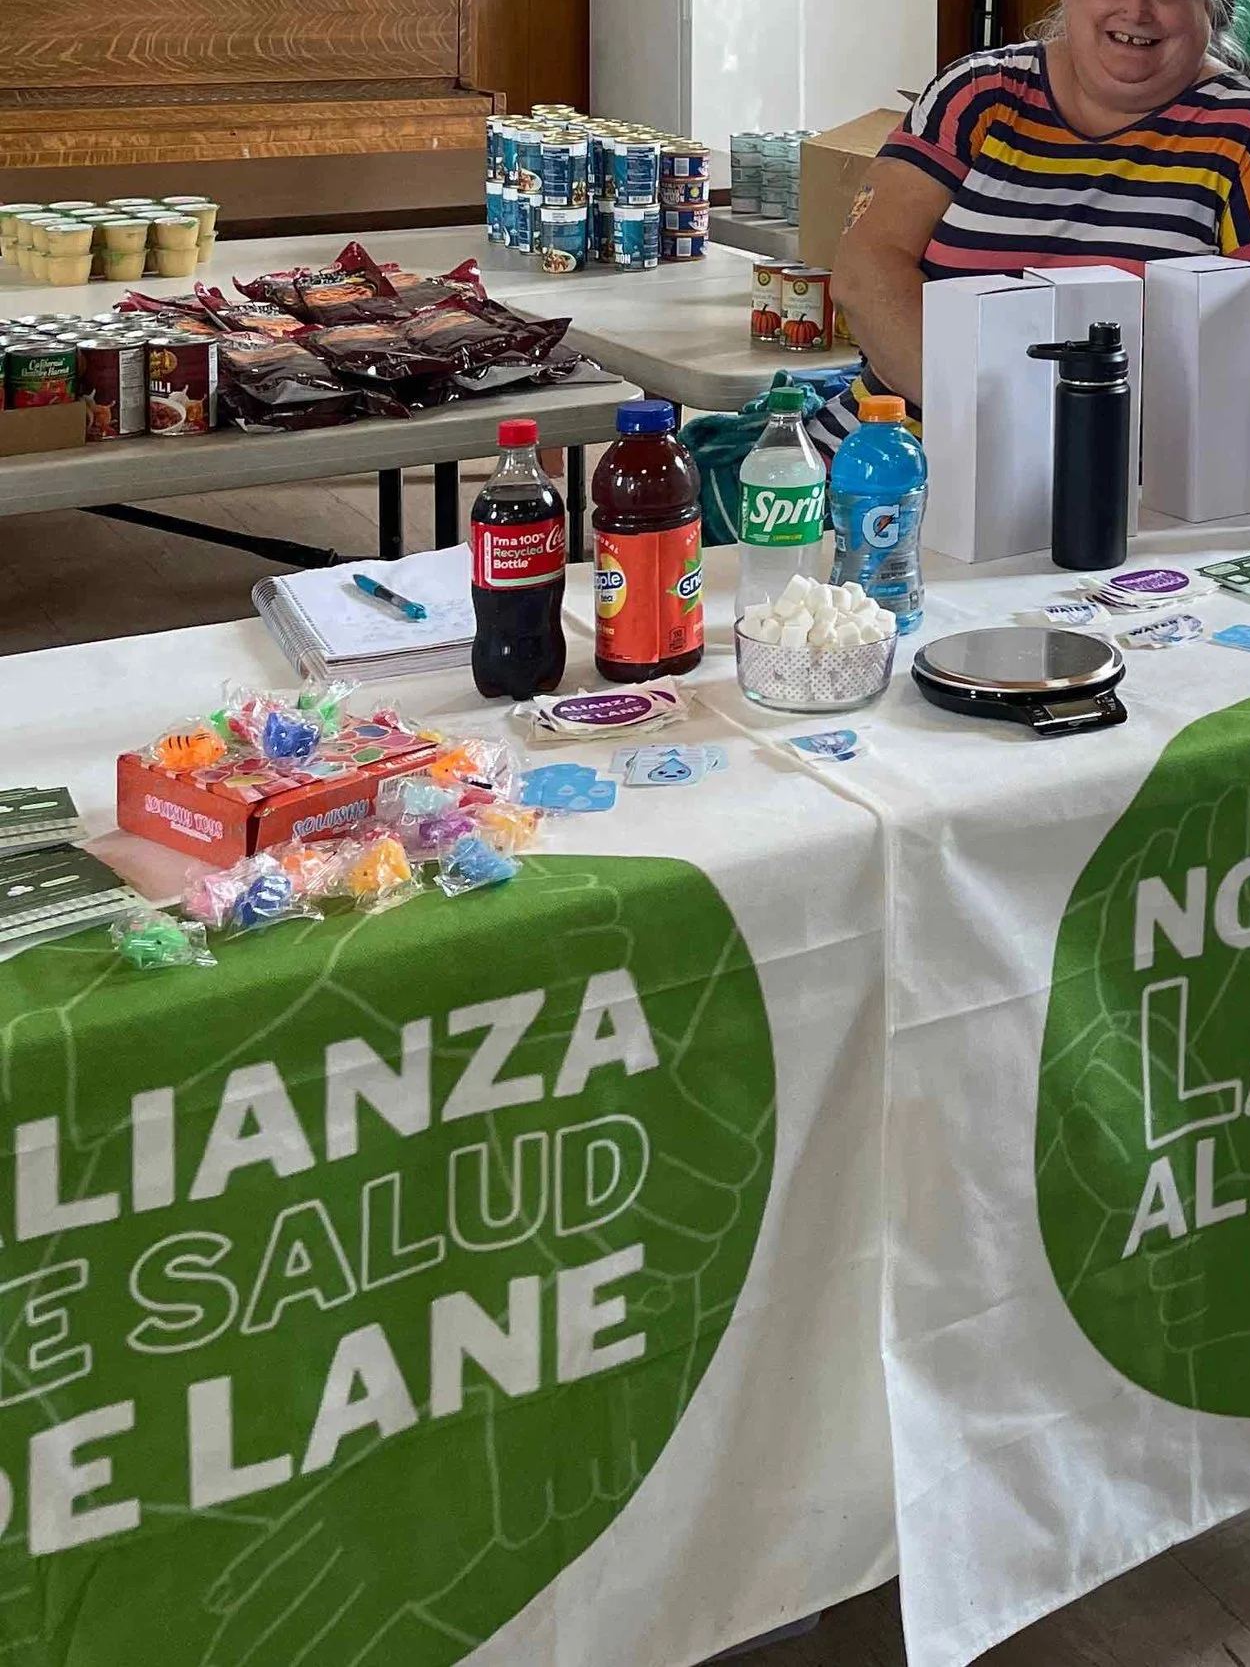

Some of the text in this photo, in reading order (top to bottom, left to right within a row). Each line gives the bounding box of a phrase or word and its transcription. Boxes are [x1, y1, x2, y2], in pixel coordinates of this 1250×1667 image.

[750, 486, 825, 532] Sprit
[862, 504, 900, 548] G
[493, 536, 510, 546] I'm
[510, 538, 518, 546] a
[493, 544, 544, 559] Recycled
[559, 697, 638, 713] ALIANZA
[567, 705, 646, 721] DE LANE
[145, 794, 193, 828] SQUISHY
[193, 813, 223, 840] TOYS
[292, 798, 369, 839] SQUISHY
[0, 967, 660, 1248] LIANZA
[0, 1113, 650, 1408] E SALUD
[0, 1243, 648, 1557] E LANE
